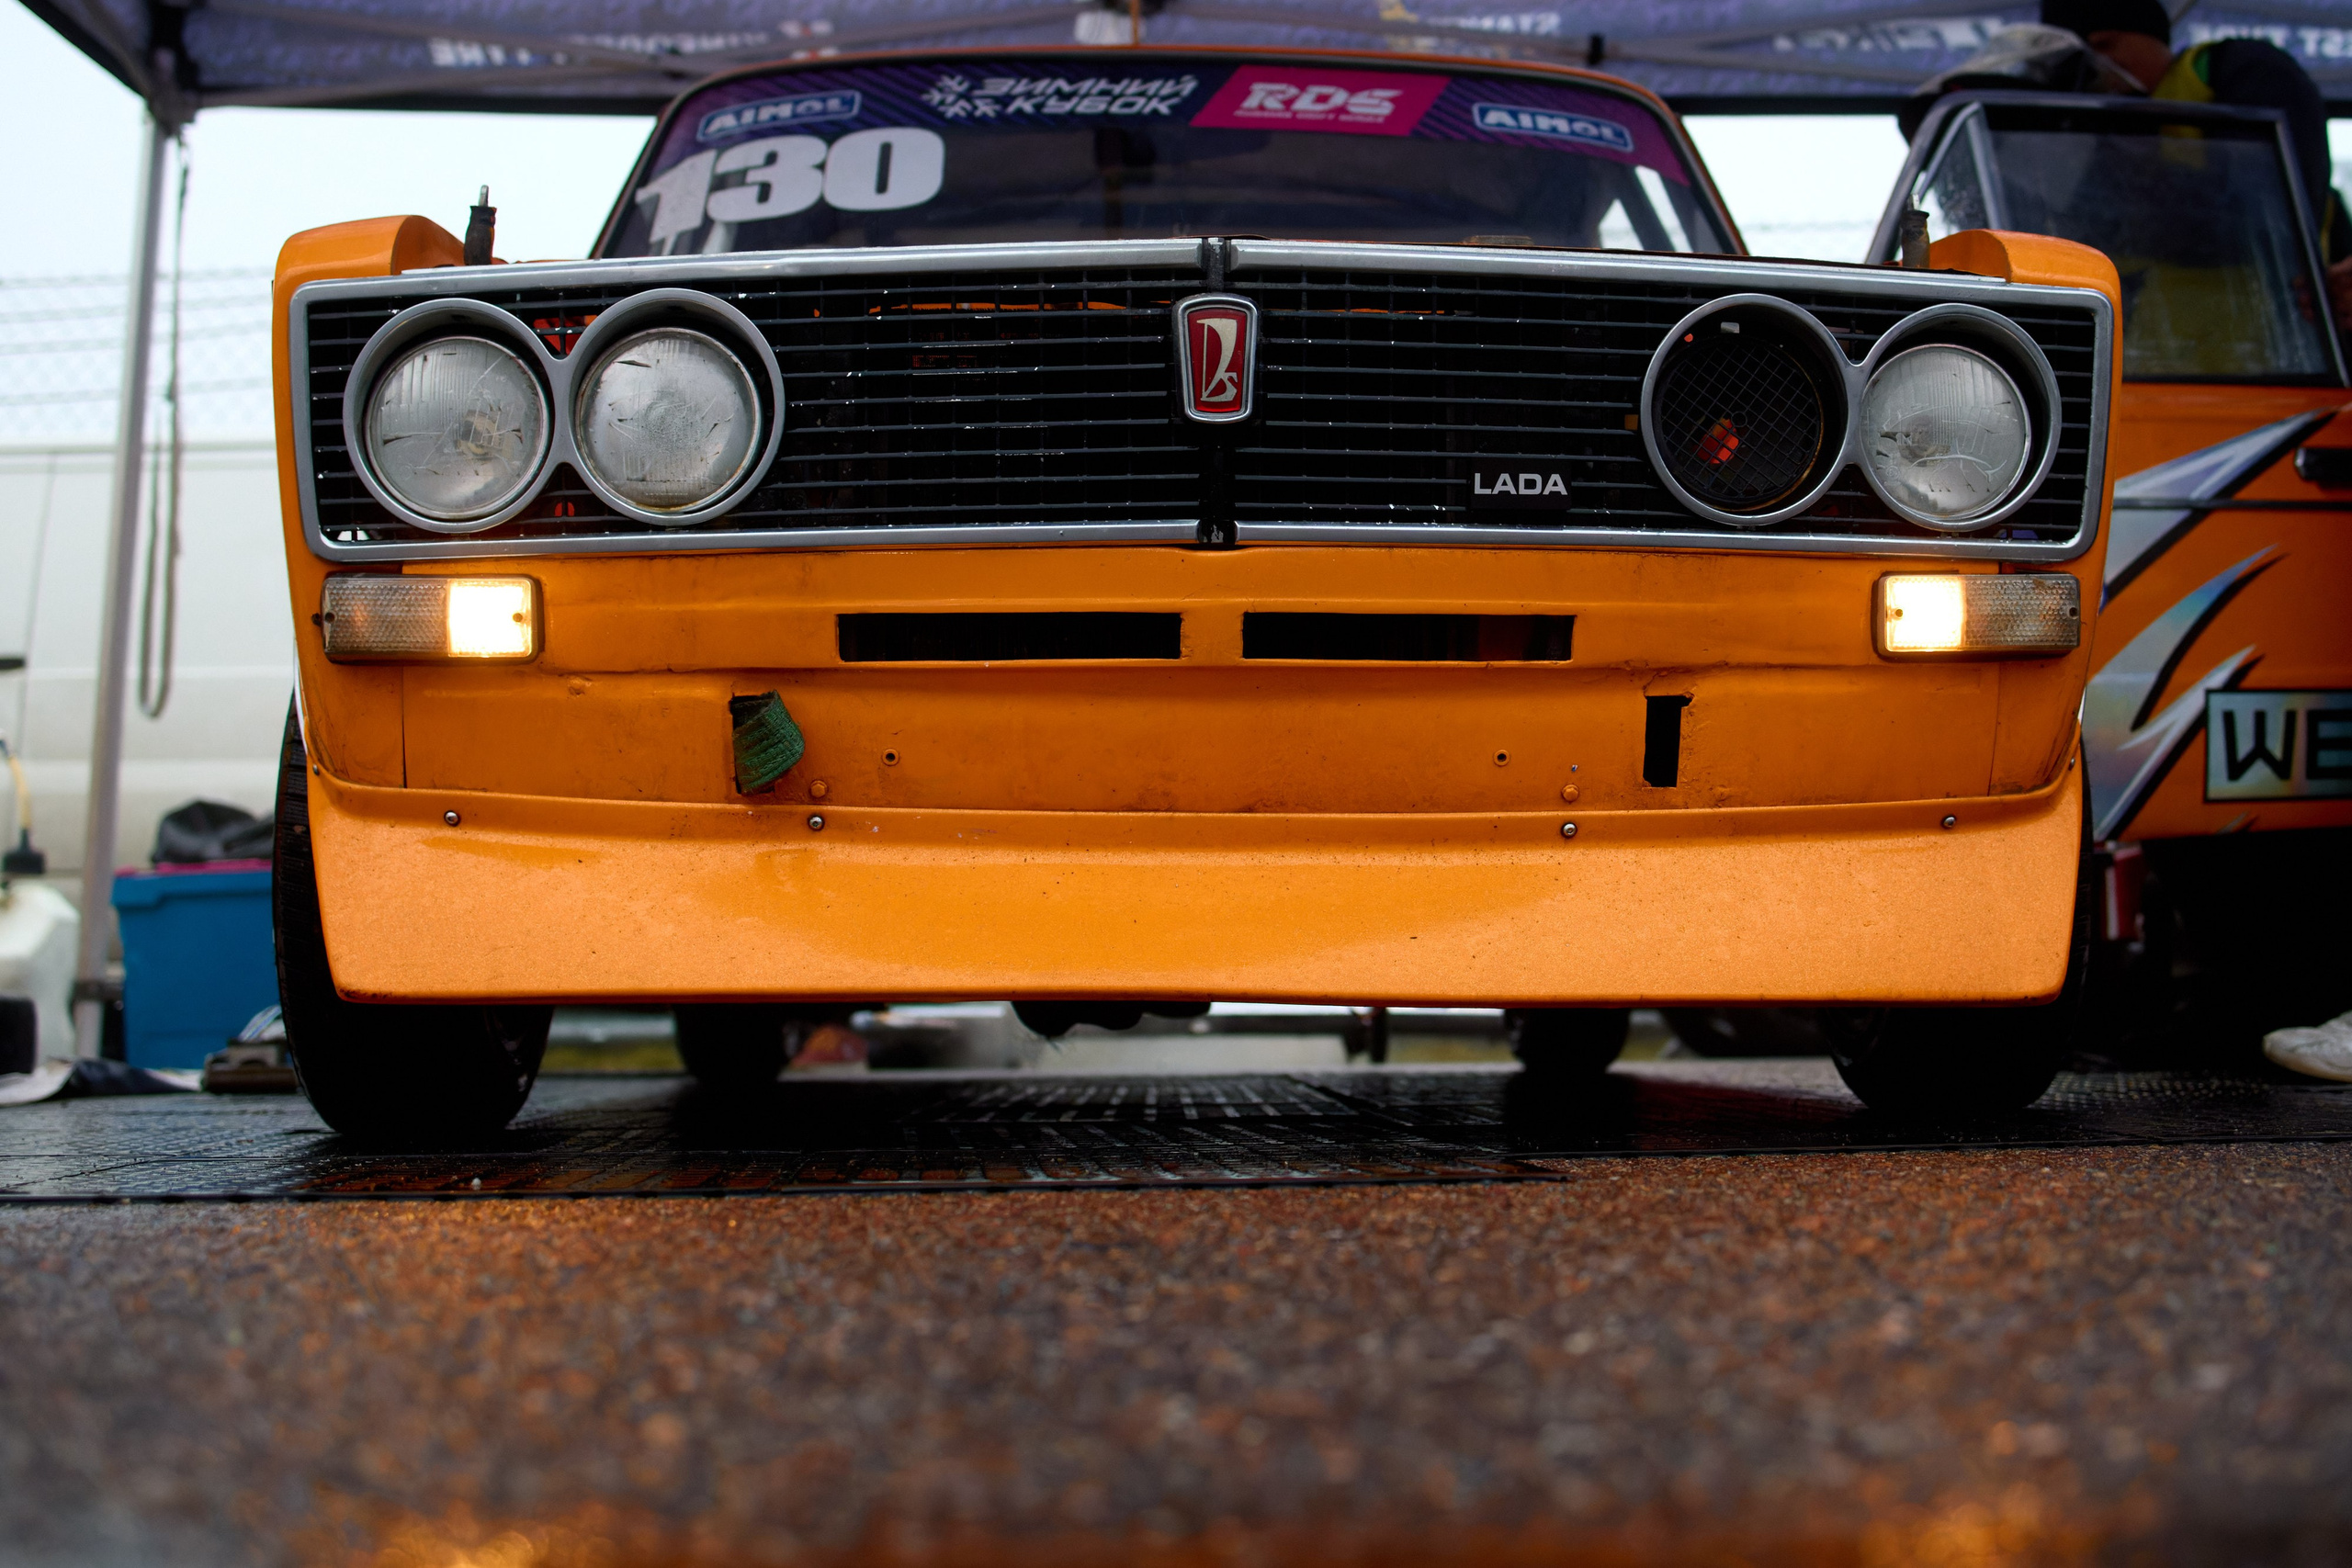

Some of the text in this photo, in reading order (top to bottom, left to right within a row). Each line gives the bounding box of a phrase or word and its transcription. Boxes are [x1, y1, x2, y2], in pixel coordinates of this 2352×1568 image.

[971, 74, 1198, 96] ЗИМНИЙ
[1240, 81, 1404, 116] RDS
[704, 97, 852, 135] AIMOL
[1005, 95, 1183, 116] КУБОК
[1483, 109, 1627, 145] AIMOL
[635, 127, 945, 244] 130
[1474, 472, 1568, 495] LADA
[2222, 709, 2352, 782] WE
